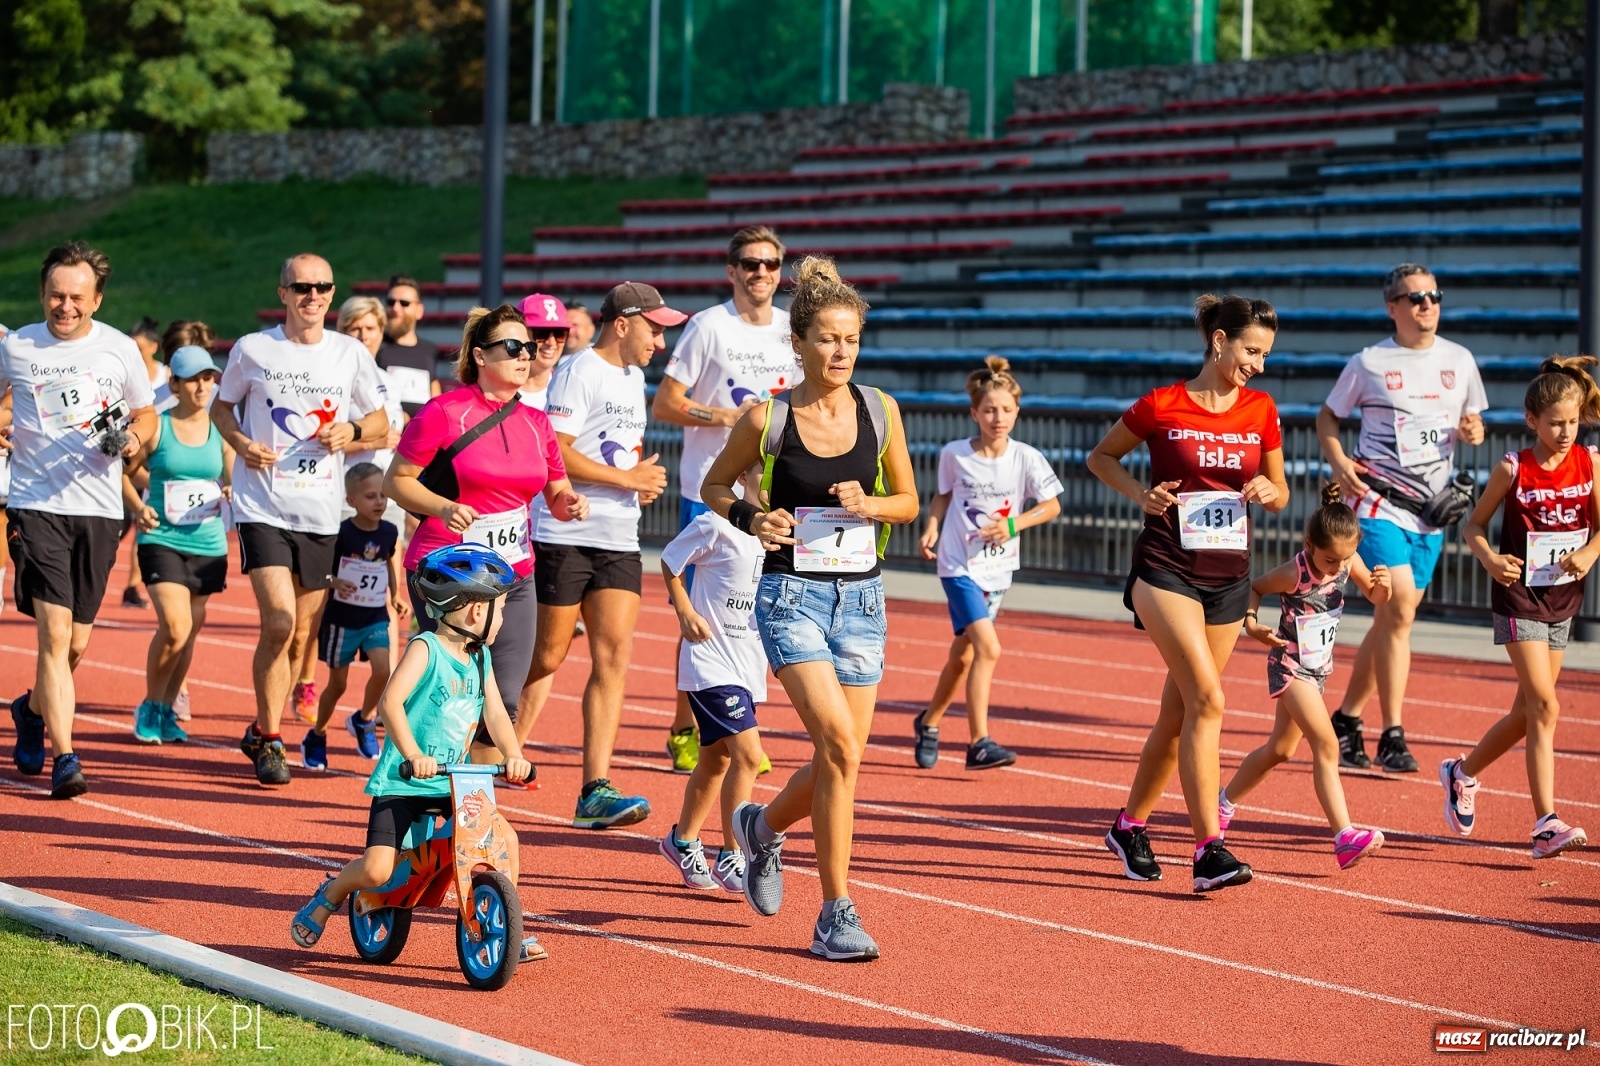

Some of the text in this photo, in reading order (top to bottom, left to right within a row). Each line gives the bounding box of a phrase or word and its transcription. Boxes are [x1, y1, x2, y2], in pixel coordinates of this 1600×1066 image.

[60, 389, 80, 408] 13
[1168, 428, 1262, 444] DAR-BUD
[1420, 430, 1438, 445] 30
[298, 458, 317, 474] 58
[188, 493, 204, 508] 55
[1203, 508, 1234, 528] 131
[486, 526, 517, 548] 166
[834, 526, 845, 548] 7
[360, 574, 378, 590] 57
[726, 598, 754, 611] RUN
